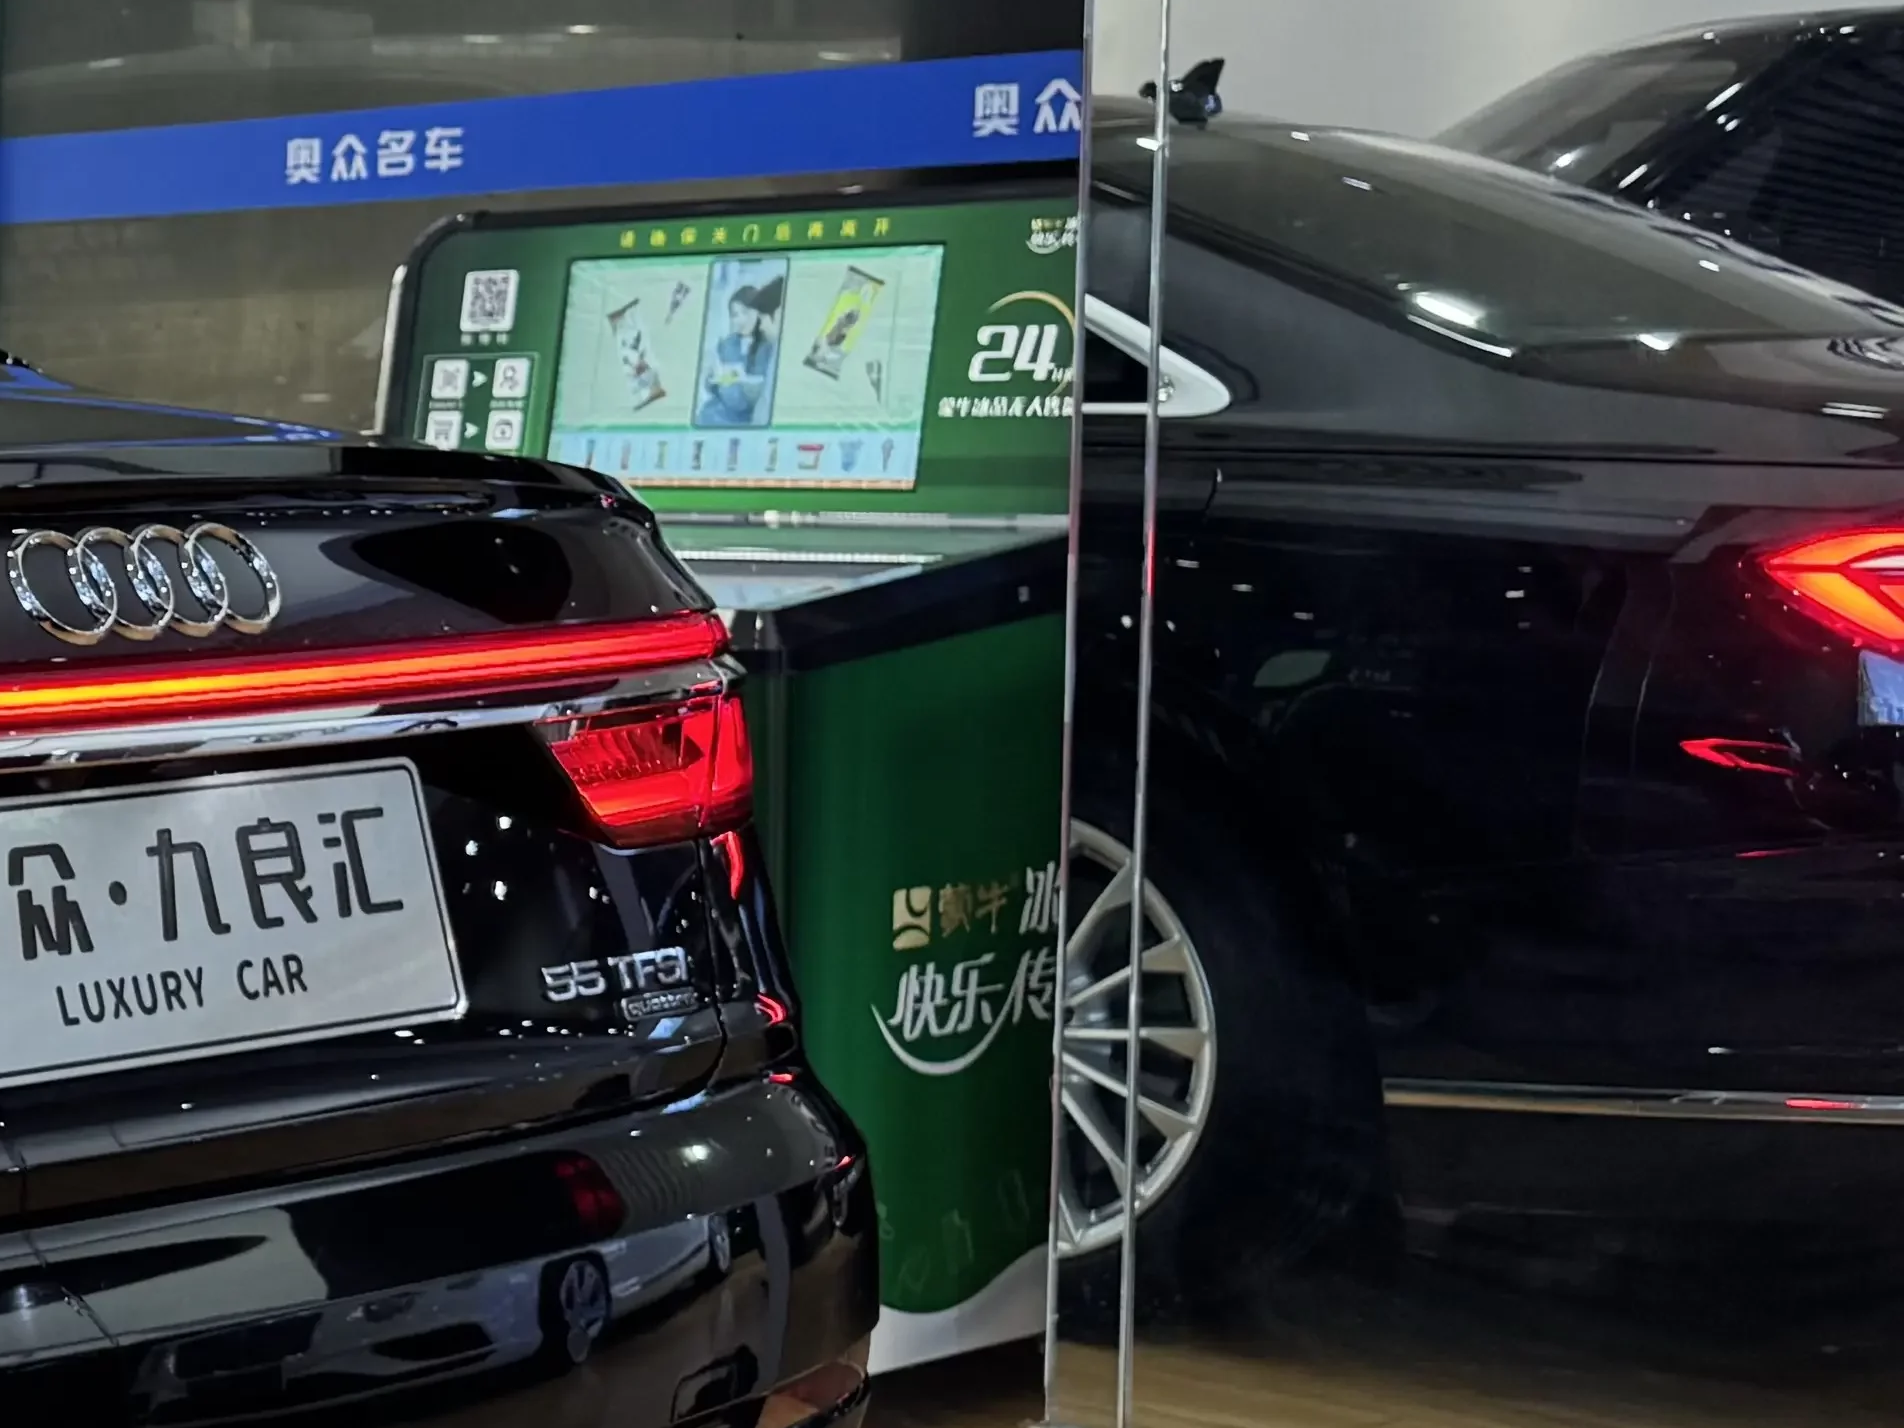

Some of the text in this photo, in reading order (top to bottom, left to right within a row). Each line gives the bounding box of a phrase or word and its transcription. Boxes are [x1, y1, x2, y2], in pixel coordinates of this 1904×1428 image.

[972, 77, 1081, 137] 奥众
[285, 127, 464, 184] 奥众名车
[968, 324, 1059, 382] 24
[56, 954, 308, 1026] LUXURY CAR
[541, 946, 688, 1002] 55 TFSI
